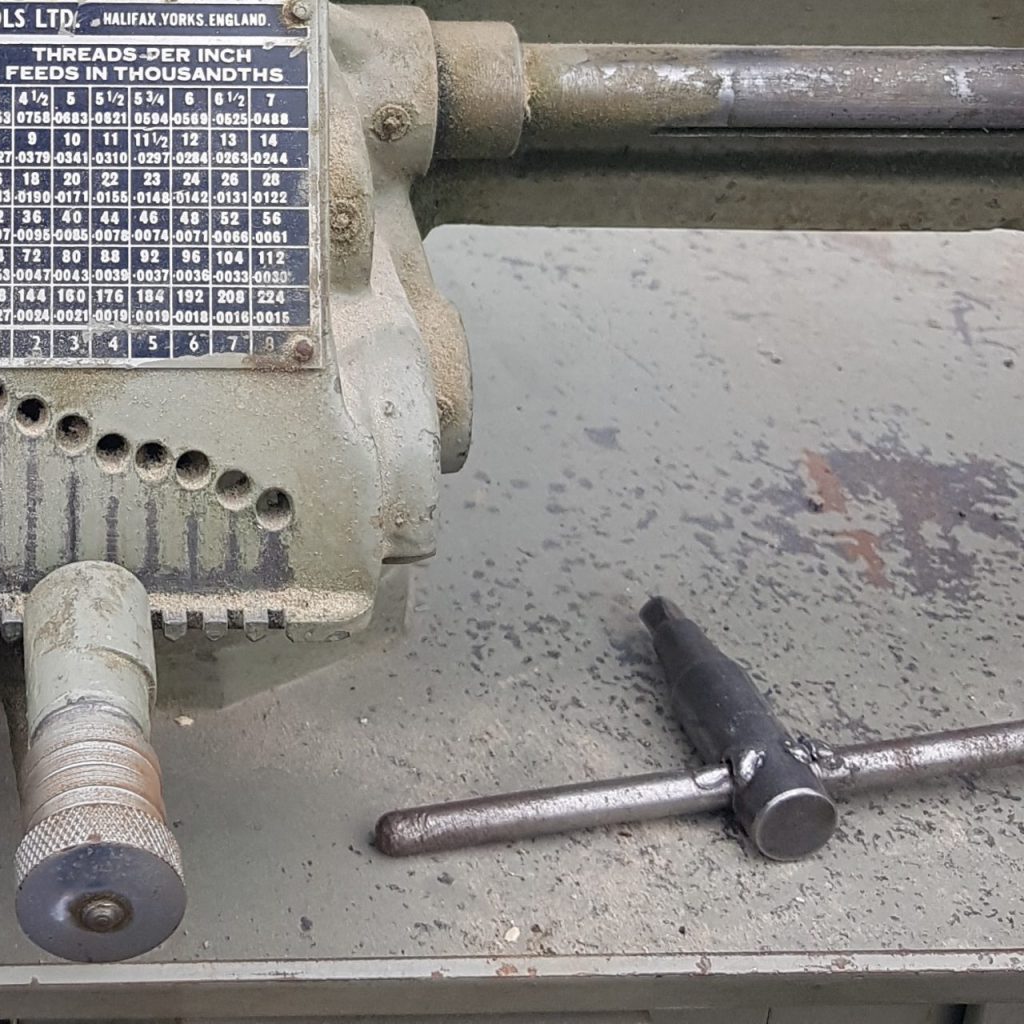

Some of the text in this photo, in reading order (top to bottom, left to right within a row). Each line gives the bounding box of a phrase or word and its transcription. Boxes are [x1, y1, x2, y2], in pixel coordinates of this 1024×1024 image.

[32, 47, 252, 63] THREADS PER INCH
[6, 66, 284, 82] FEEDS IN THOUSANDTHS
[19, 91, 28, 105] 4
[66, 91, 75, 105] 5
[95, 91, 104, 105] 5
[134, 91, 142, 105] 5
[185, 92, 194, 105] 6
[214, 92, 223, 106] 6
[266, 93, 275, 106] 7
[27, 132, 37, 146] 9
[63, 132, 80, 146] 10
[103, 132, 118, 146] 11
[182, 133, 199, 146] 12
[220, 133, 237, 146] 13
[260, 133, 277, 147] 14
[23, 172, 40, 186] 18
[63, 172, 80, 186] 20
[101, 172, 119, 186] 22
[144, 172, 161, 186] 23
[183, 172, 200, 186] 24
[221, 172, 238, 186] 26
[262, 172, 280, 186] 28
[22, 210, 42, 224] 36
[62, 210, 81, 224] 40
[100, 210, 119, 224] 44
[139, 210, 158, 224] 46
[180, 210, 199, 224] 48
[220, 211, 239, 225] 52
[262, 212, 281, 225] 56
[22, 249, 41, 262] 72
[62, 250, 81, 263] 80
[100, 250, 120, 263] 88
[140, 250, 159, 263] 92
[182, 250, 200, 263] 96
[216, 251, 244, 264] 104
[258, 251, 285, 265] 112
[18, 289, 46, 303] 144
[58, 289, 86, 303] 160
[96, 289, 123, 303] 176
[137, 289, 164, 303] 184
[177, 289, 204, 303] 192
[217, 290, 245, 304] 208
[257, 290, 285, 304] 224
[31, 335, 41, 351] 2
[70, 335, 80, 351] 3
[108, 335, 118, 351] 4
[148, 335, 158, 351] 5
[189, 335, 199, 351] 6
[226, 335, 238, 351] 7
[265, 336, 274, 351] 8
